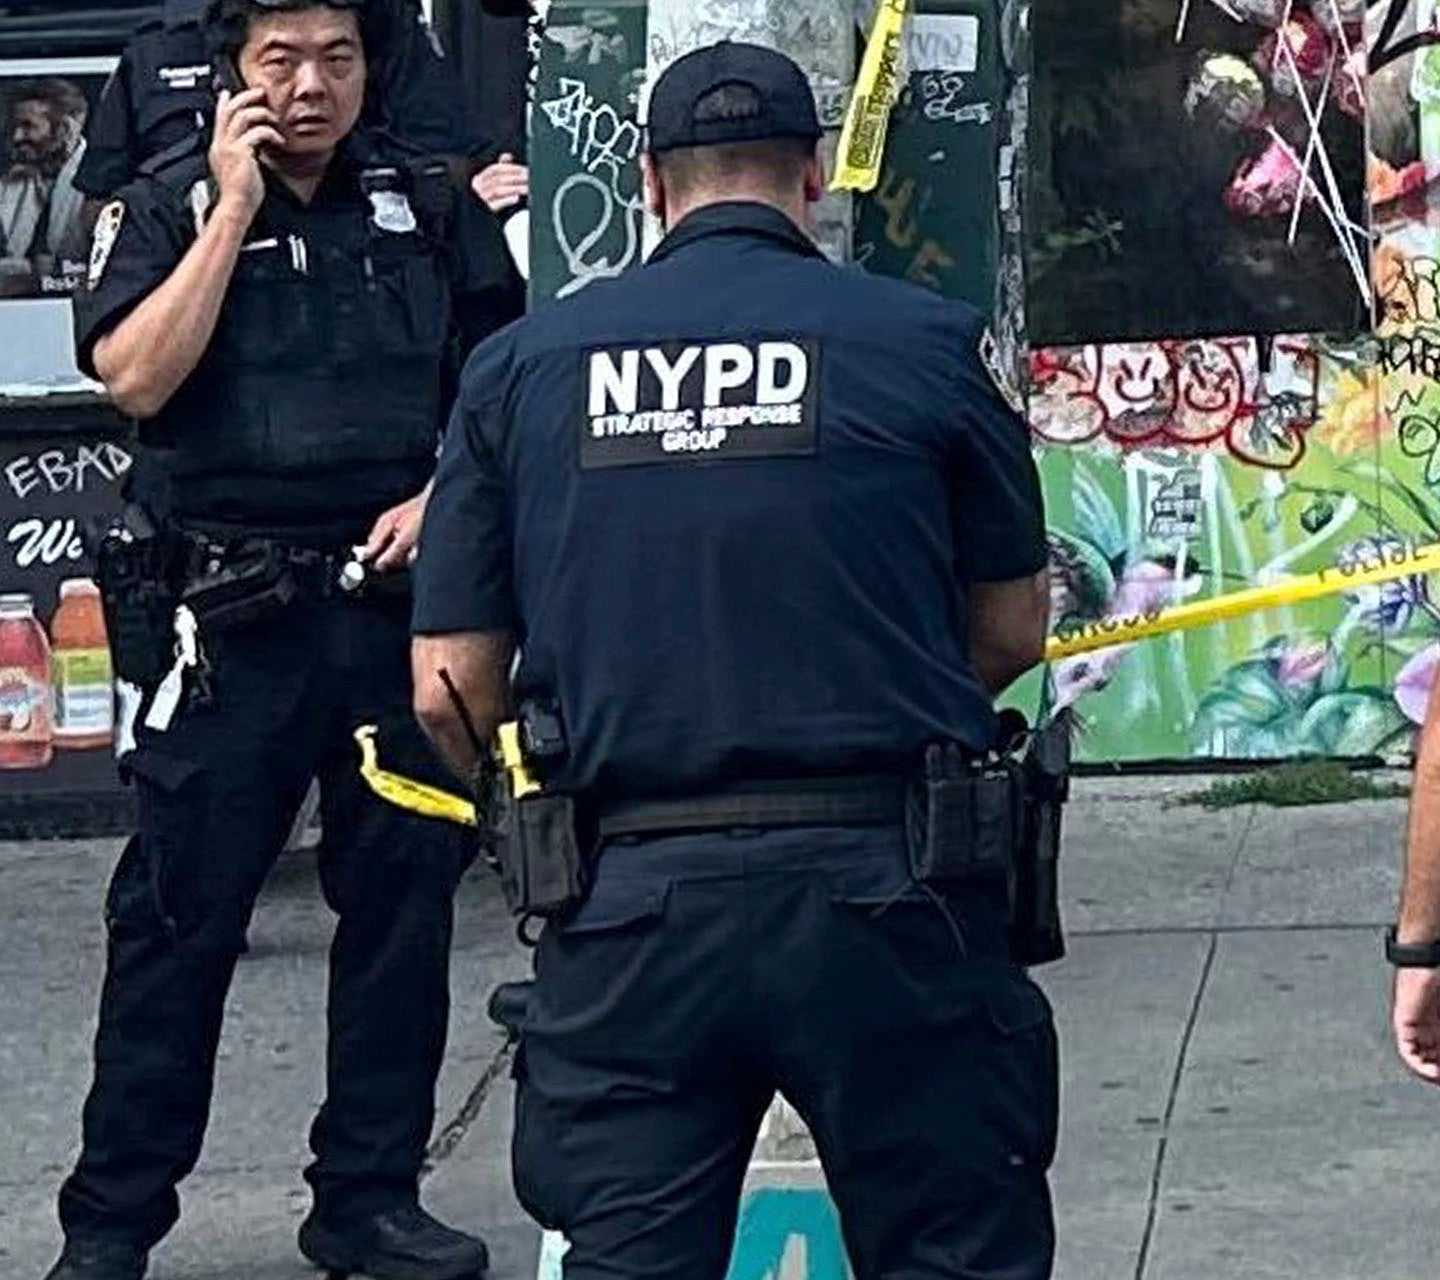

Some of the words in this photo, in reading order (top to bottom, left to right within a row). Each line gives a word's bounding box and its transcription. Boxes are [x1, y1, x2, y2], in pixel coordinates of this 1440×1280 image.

[588, 341, 808, 417] NYPD
[592, 409, 695, 438] STRATEGIC
[661, 427, 728, 453] GROUP
